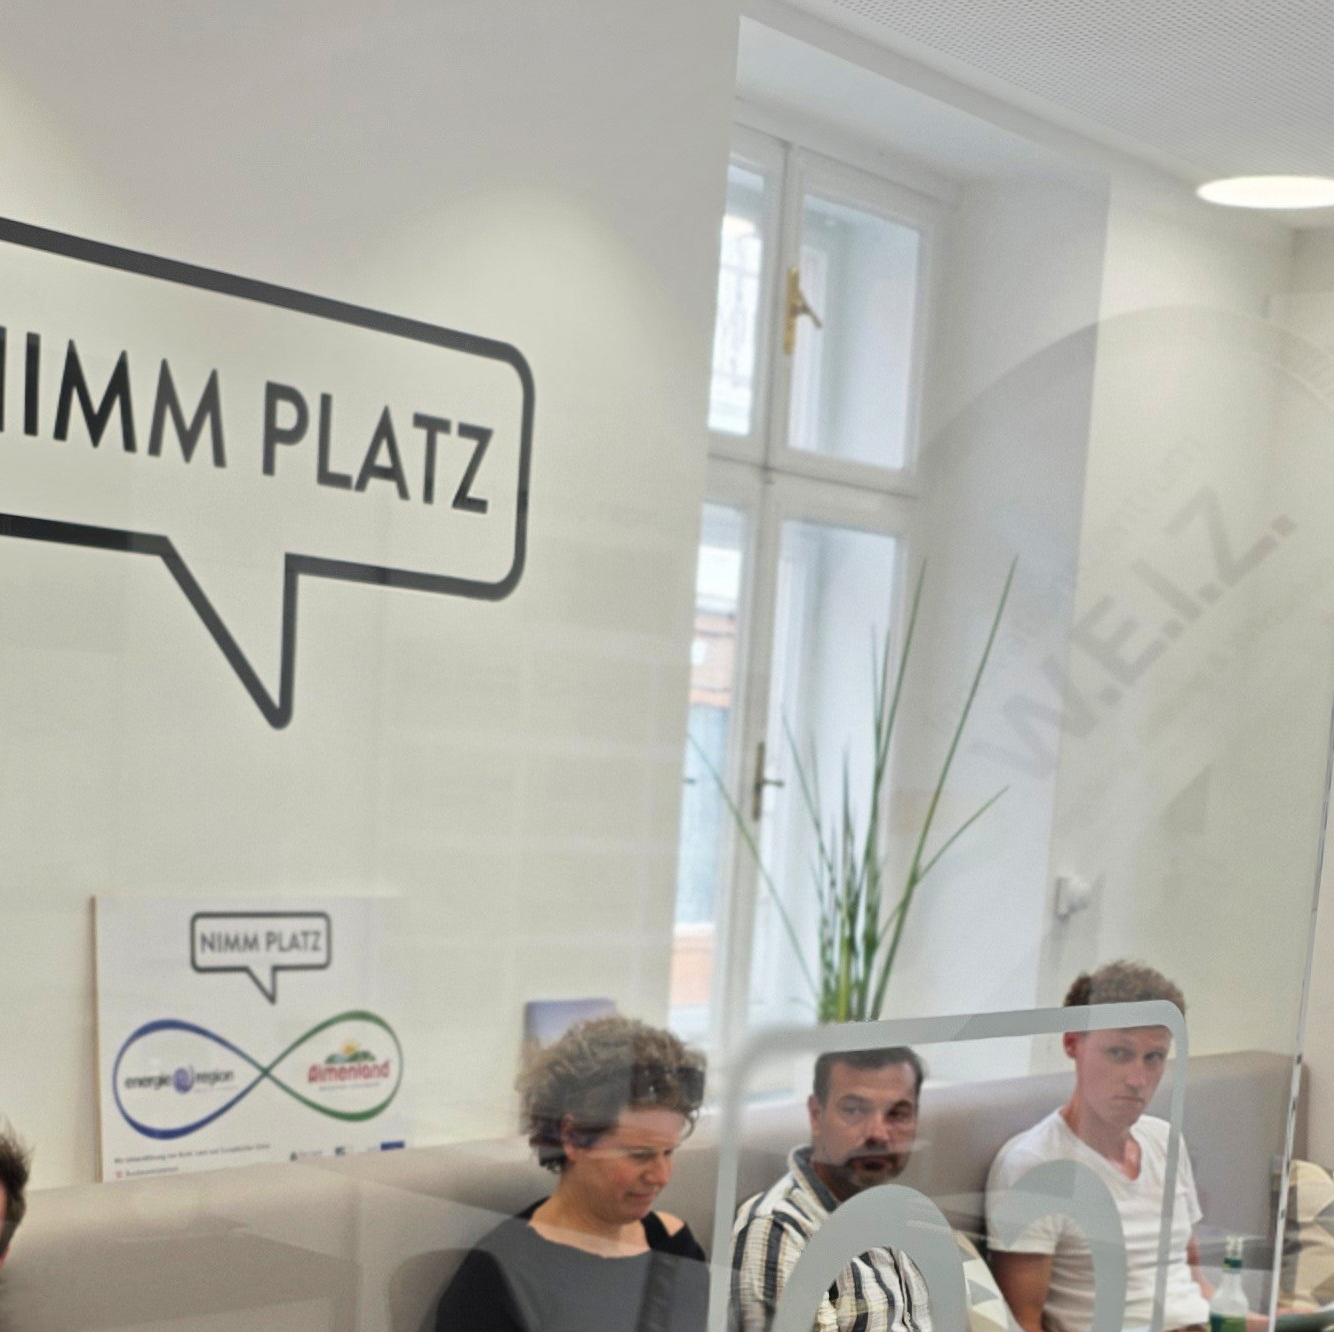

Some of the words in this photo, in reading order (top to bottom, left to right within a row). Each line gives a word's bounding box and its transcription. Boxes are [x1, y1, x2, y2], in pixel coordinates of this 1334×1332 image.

[262, 380, 494, 515] PLATZ
[967, 486, 1298, 784] W.E.I.Z.
[200, 932, 260, 953] NIMM
[266, 930, 322, 951] PLATZ
